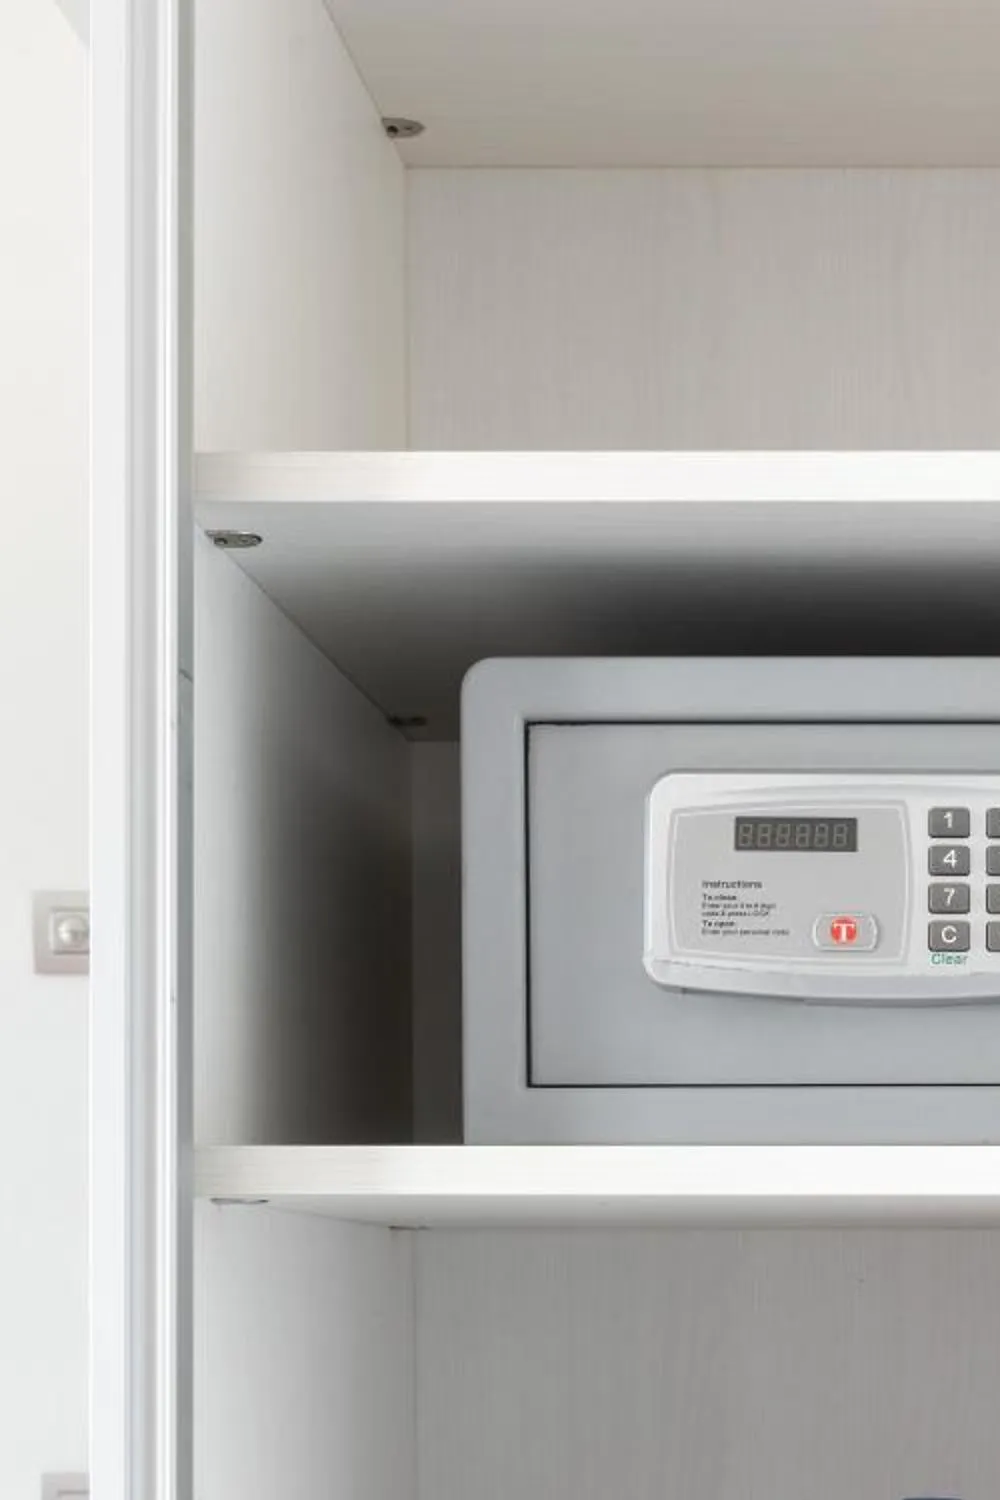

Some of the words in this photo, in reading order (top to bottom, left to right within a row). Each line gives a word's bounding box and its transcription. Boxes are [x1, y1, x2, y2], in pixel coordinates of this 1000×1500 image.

[943, 811, 953, 829] 1
[942, 849, 958, 868] 4
[943, 887, 956, 907] 7
[941, 925, 958, 944] C
[930, 953, 968, 966] Clear
